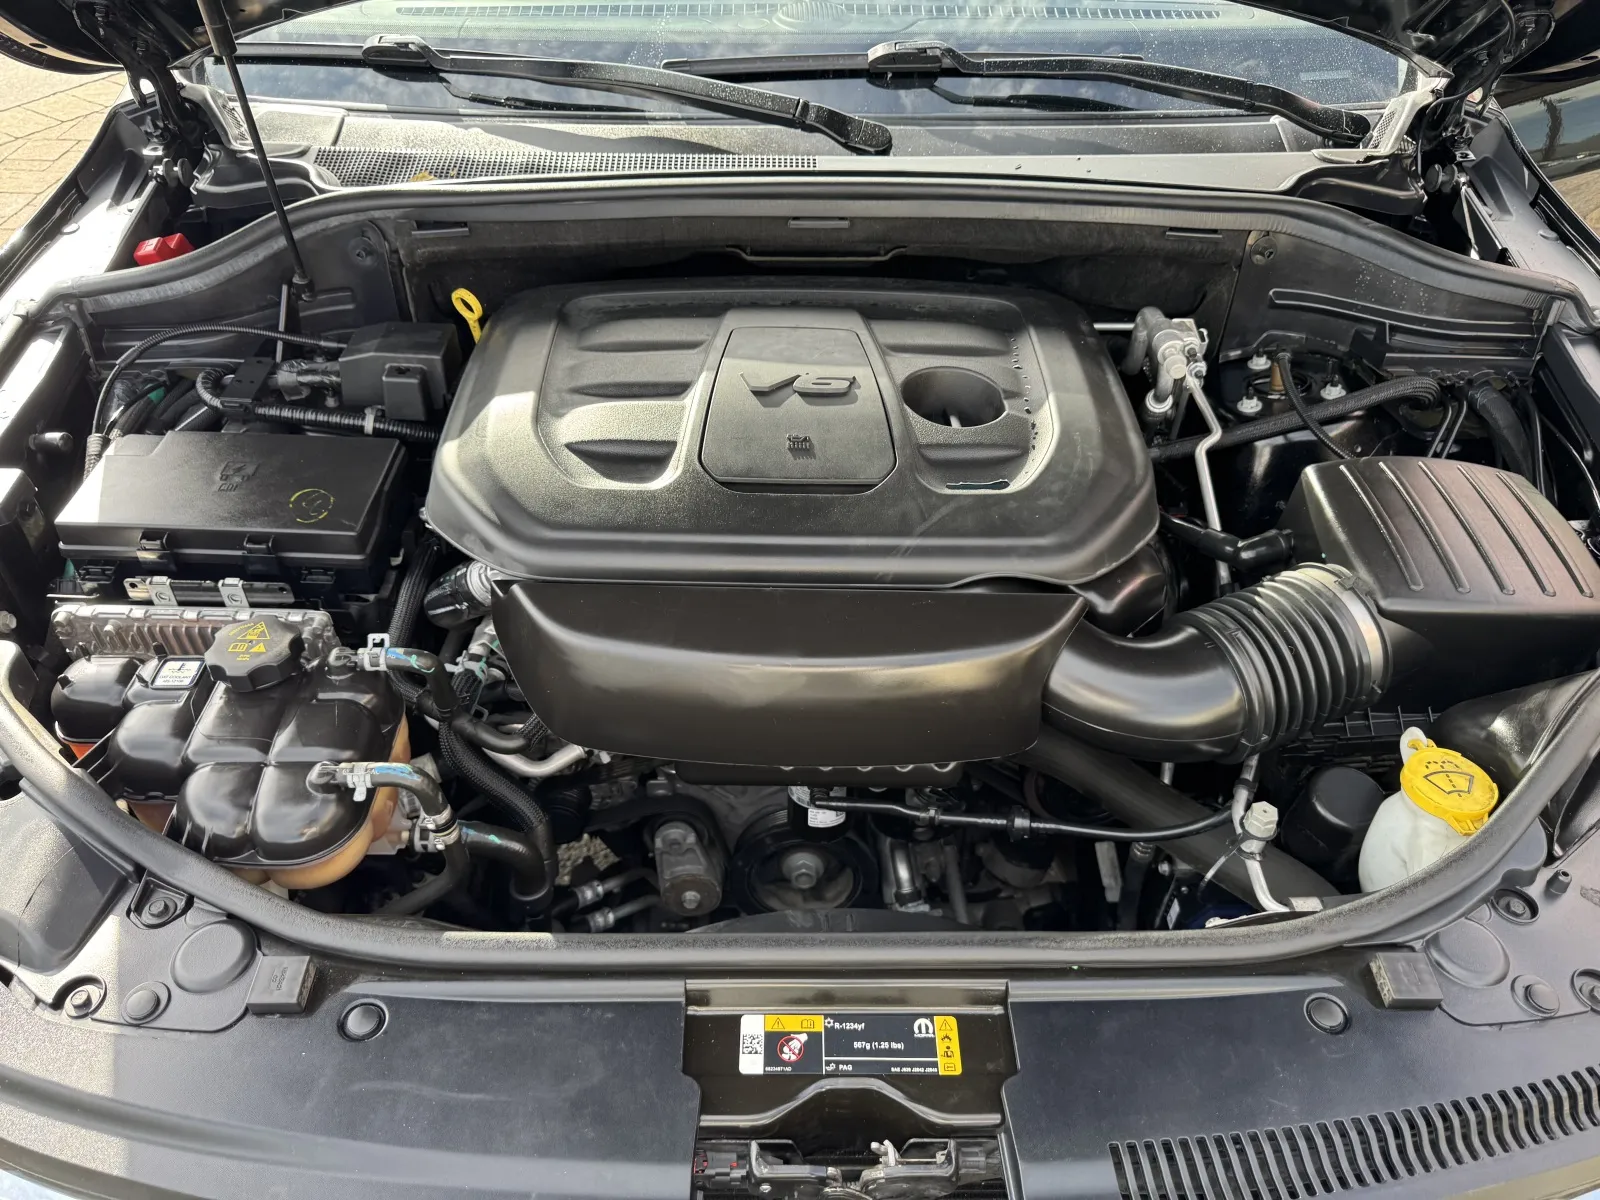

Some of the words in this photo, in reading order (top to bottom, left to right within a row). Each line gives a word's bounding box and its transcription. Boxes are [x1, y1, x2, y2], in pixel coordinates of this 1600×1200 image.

[738, 371, 857, 394] V6
[834, 1022, 865, 1030] R-1234yf
[853, 1041, 871, 1050] 567g
[872, 1041, 889, 1050] (1.25
[890, 1041, 904, 1050] lbs)
